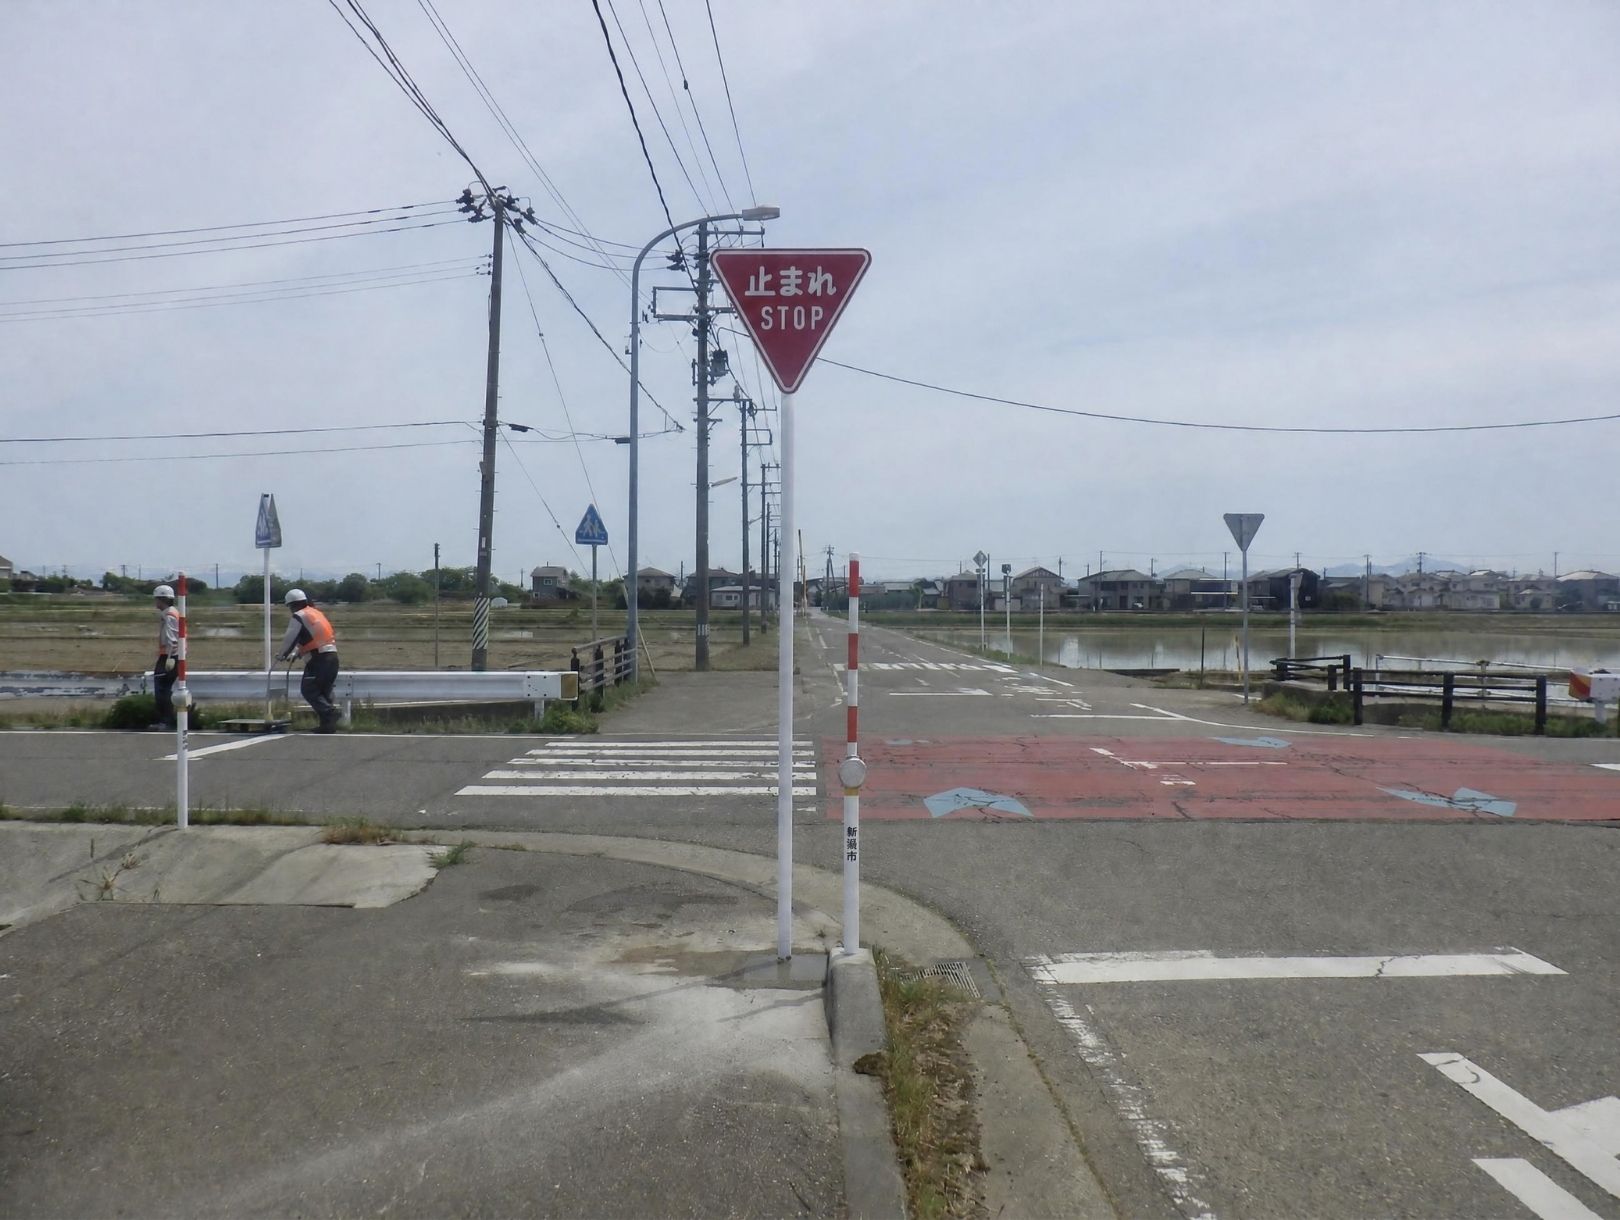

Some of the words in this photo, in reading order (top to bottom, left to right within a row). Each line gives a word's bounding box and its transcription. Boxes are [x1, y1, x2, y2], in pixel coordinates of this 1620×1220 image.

[744, 266, 837, 297] 止まれ
[761, 306, 824, 330] STOP
